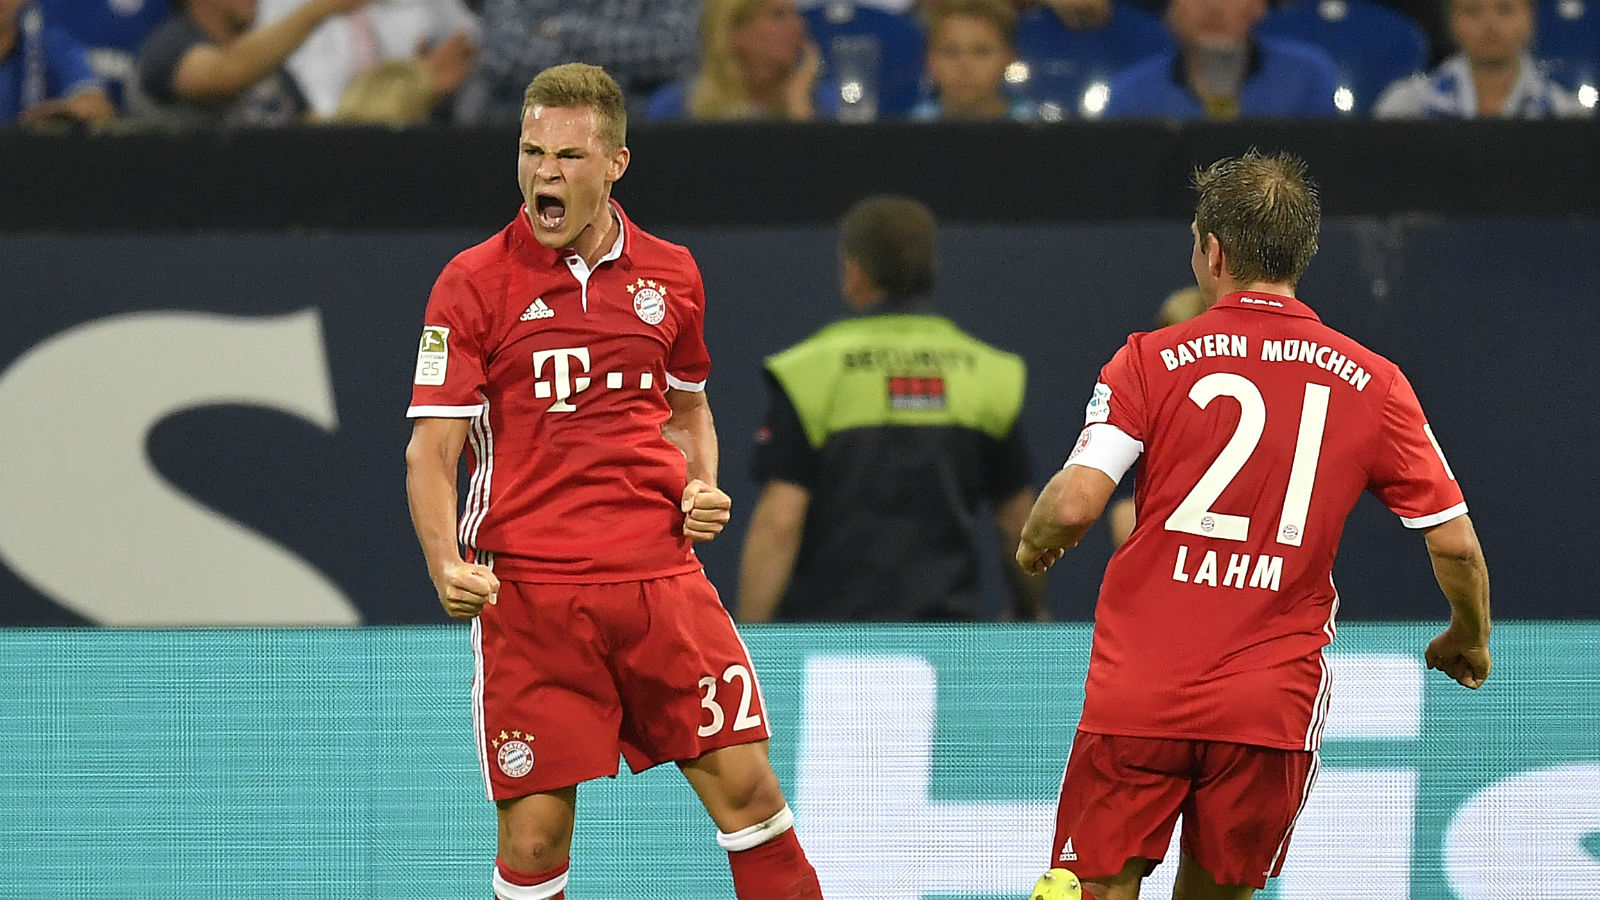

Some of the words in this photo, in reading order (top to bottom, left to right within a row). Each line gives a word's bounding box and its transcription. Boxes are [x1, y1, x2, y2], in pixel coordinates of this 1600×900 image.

[421, 361, 440, 376] 25
[1159, 333, 1248, 372] BAYERN
[1261, 339, 1372, 392] MÜNCHEN
[1164, 372, 1331, 547] 21
[1172, 545, 1284, 592] LAHM
[697, 664, 762, 737] 32
